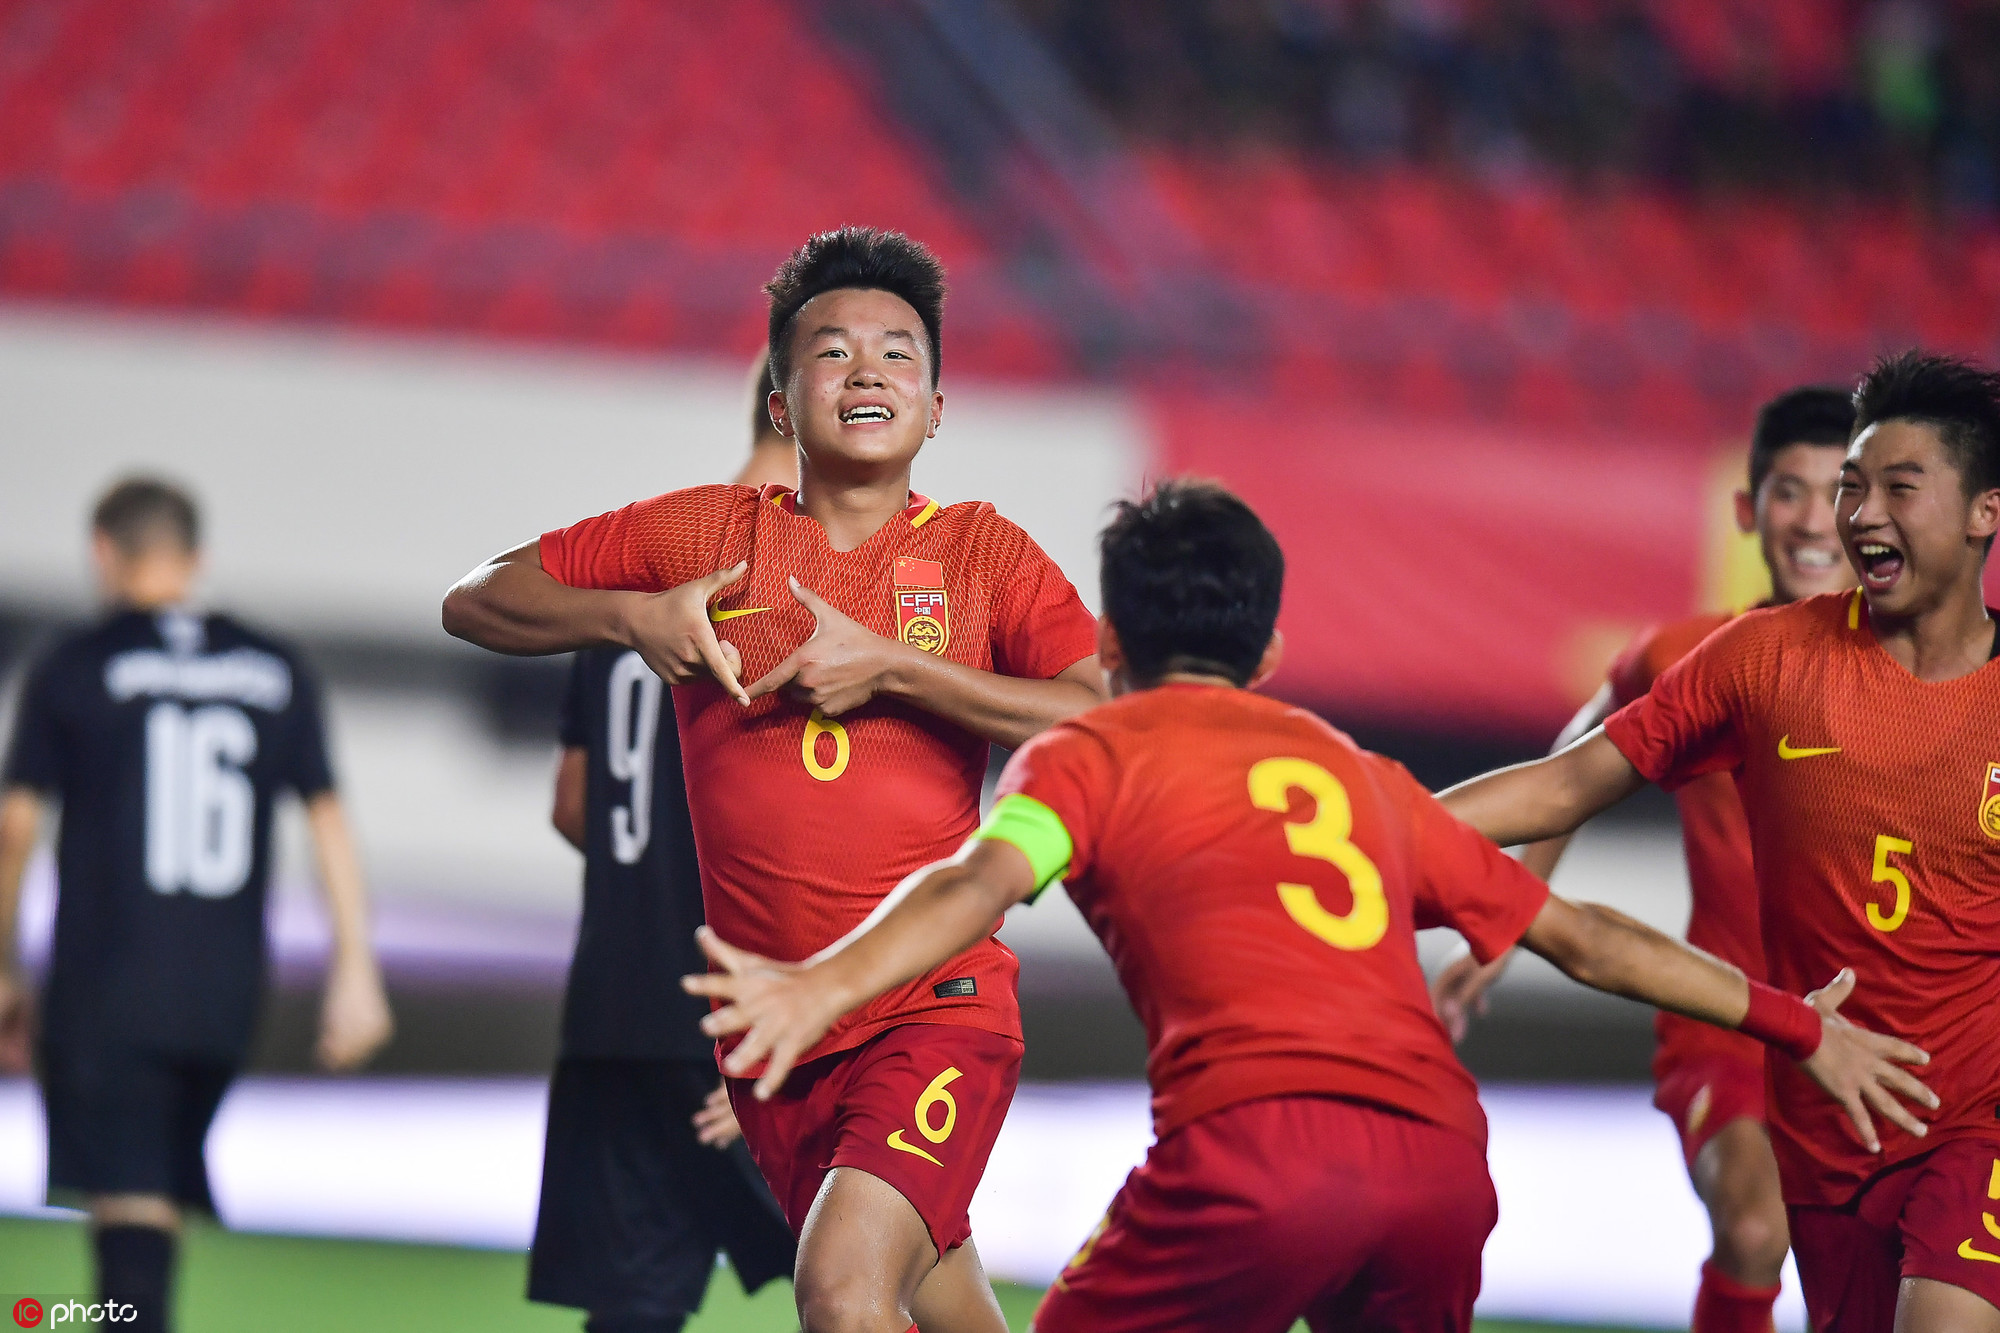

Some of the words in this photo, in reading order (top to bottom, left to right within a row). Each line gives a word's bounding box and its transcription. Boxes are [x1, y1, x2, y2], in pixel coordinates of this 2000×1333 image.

[901, 594, 943, 607] CFA
[608, 652, 663, 865] 9
[802, 708, 850, 781] 6
[145, 700, 257, 898] 16
[1247, 756, 1389, 951] 3
[1865, 834, 1913, 932] 5
[914, 1066, 964, 1144] 6
